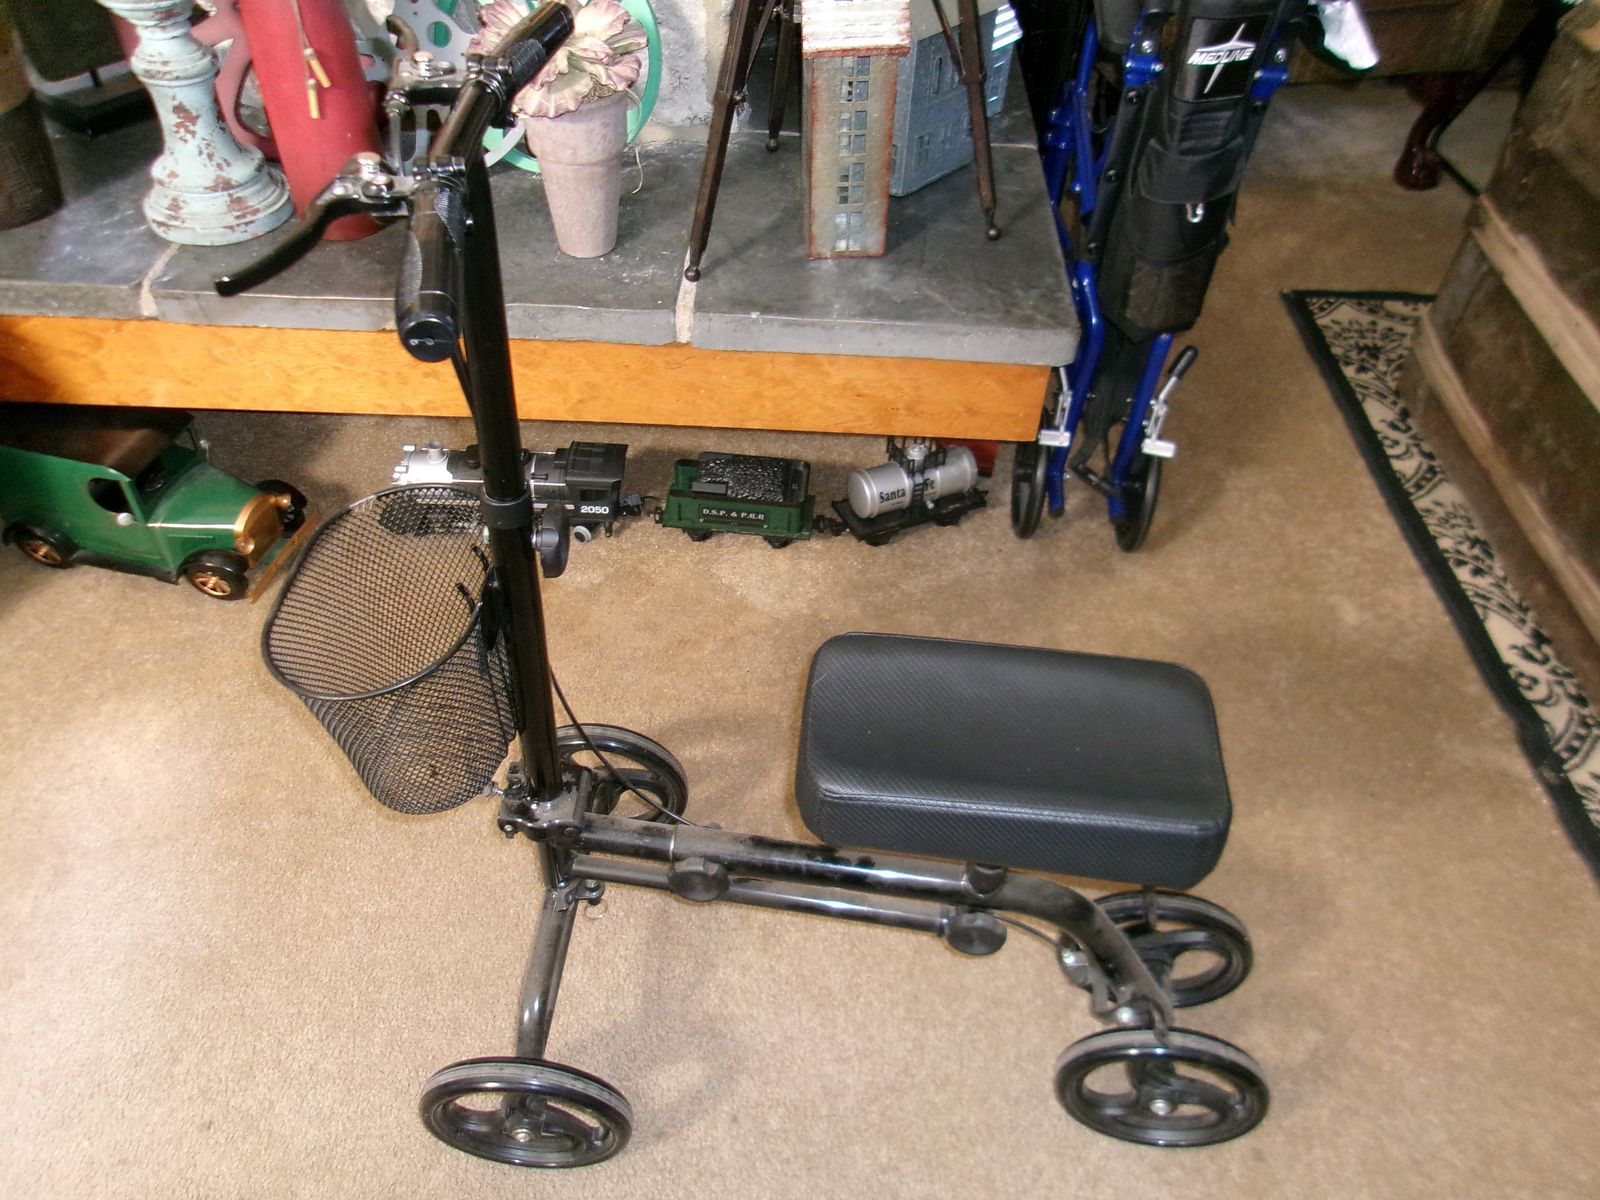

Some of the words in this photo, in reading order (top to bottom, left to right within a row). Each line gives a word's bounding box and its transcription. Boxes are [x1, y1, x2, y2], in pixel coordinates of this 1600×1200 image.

[1186, 47, 1256, 65] MEDLINE
[879, 488, 906, 503] Santa
[580, 505, 609, 514] 2050
